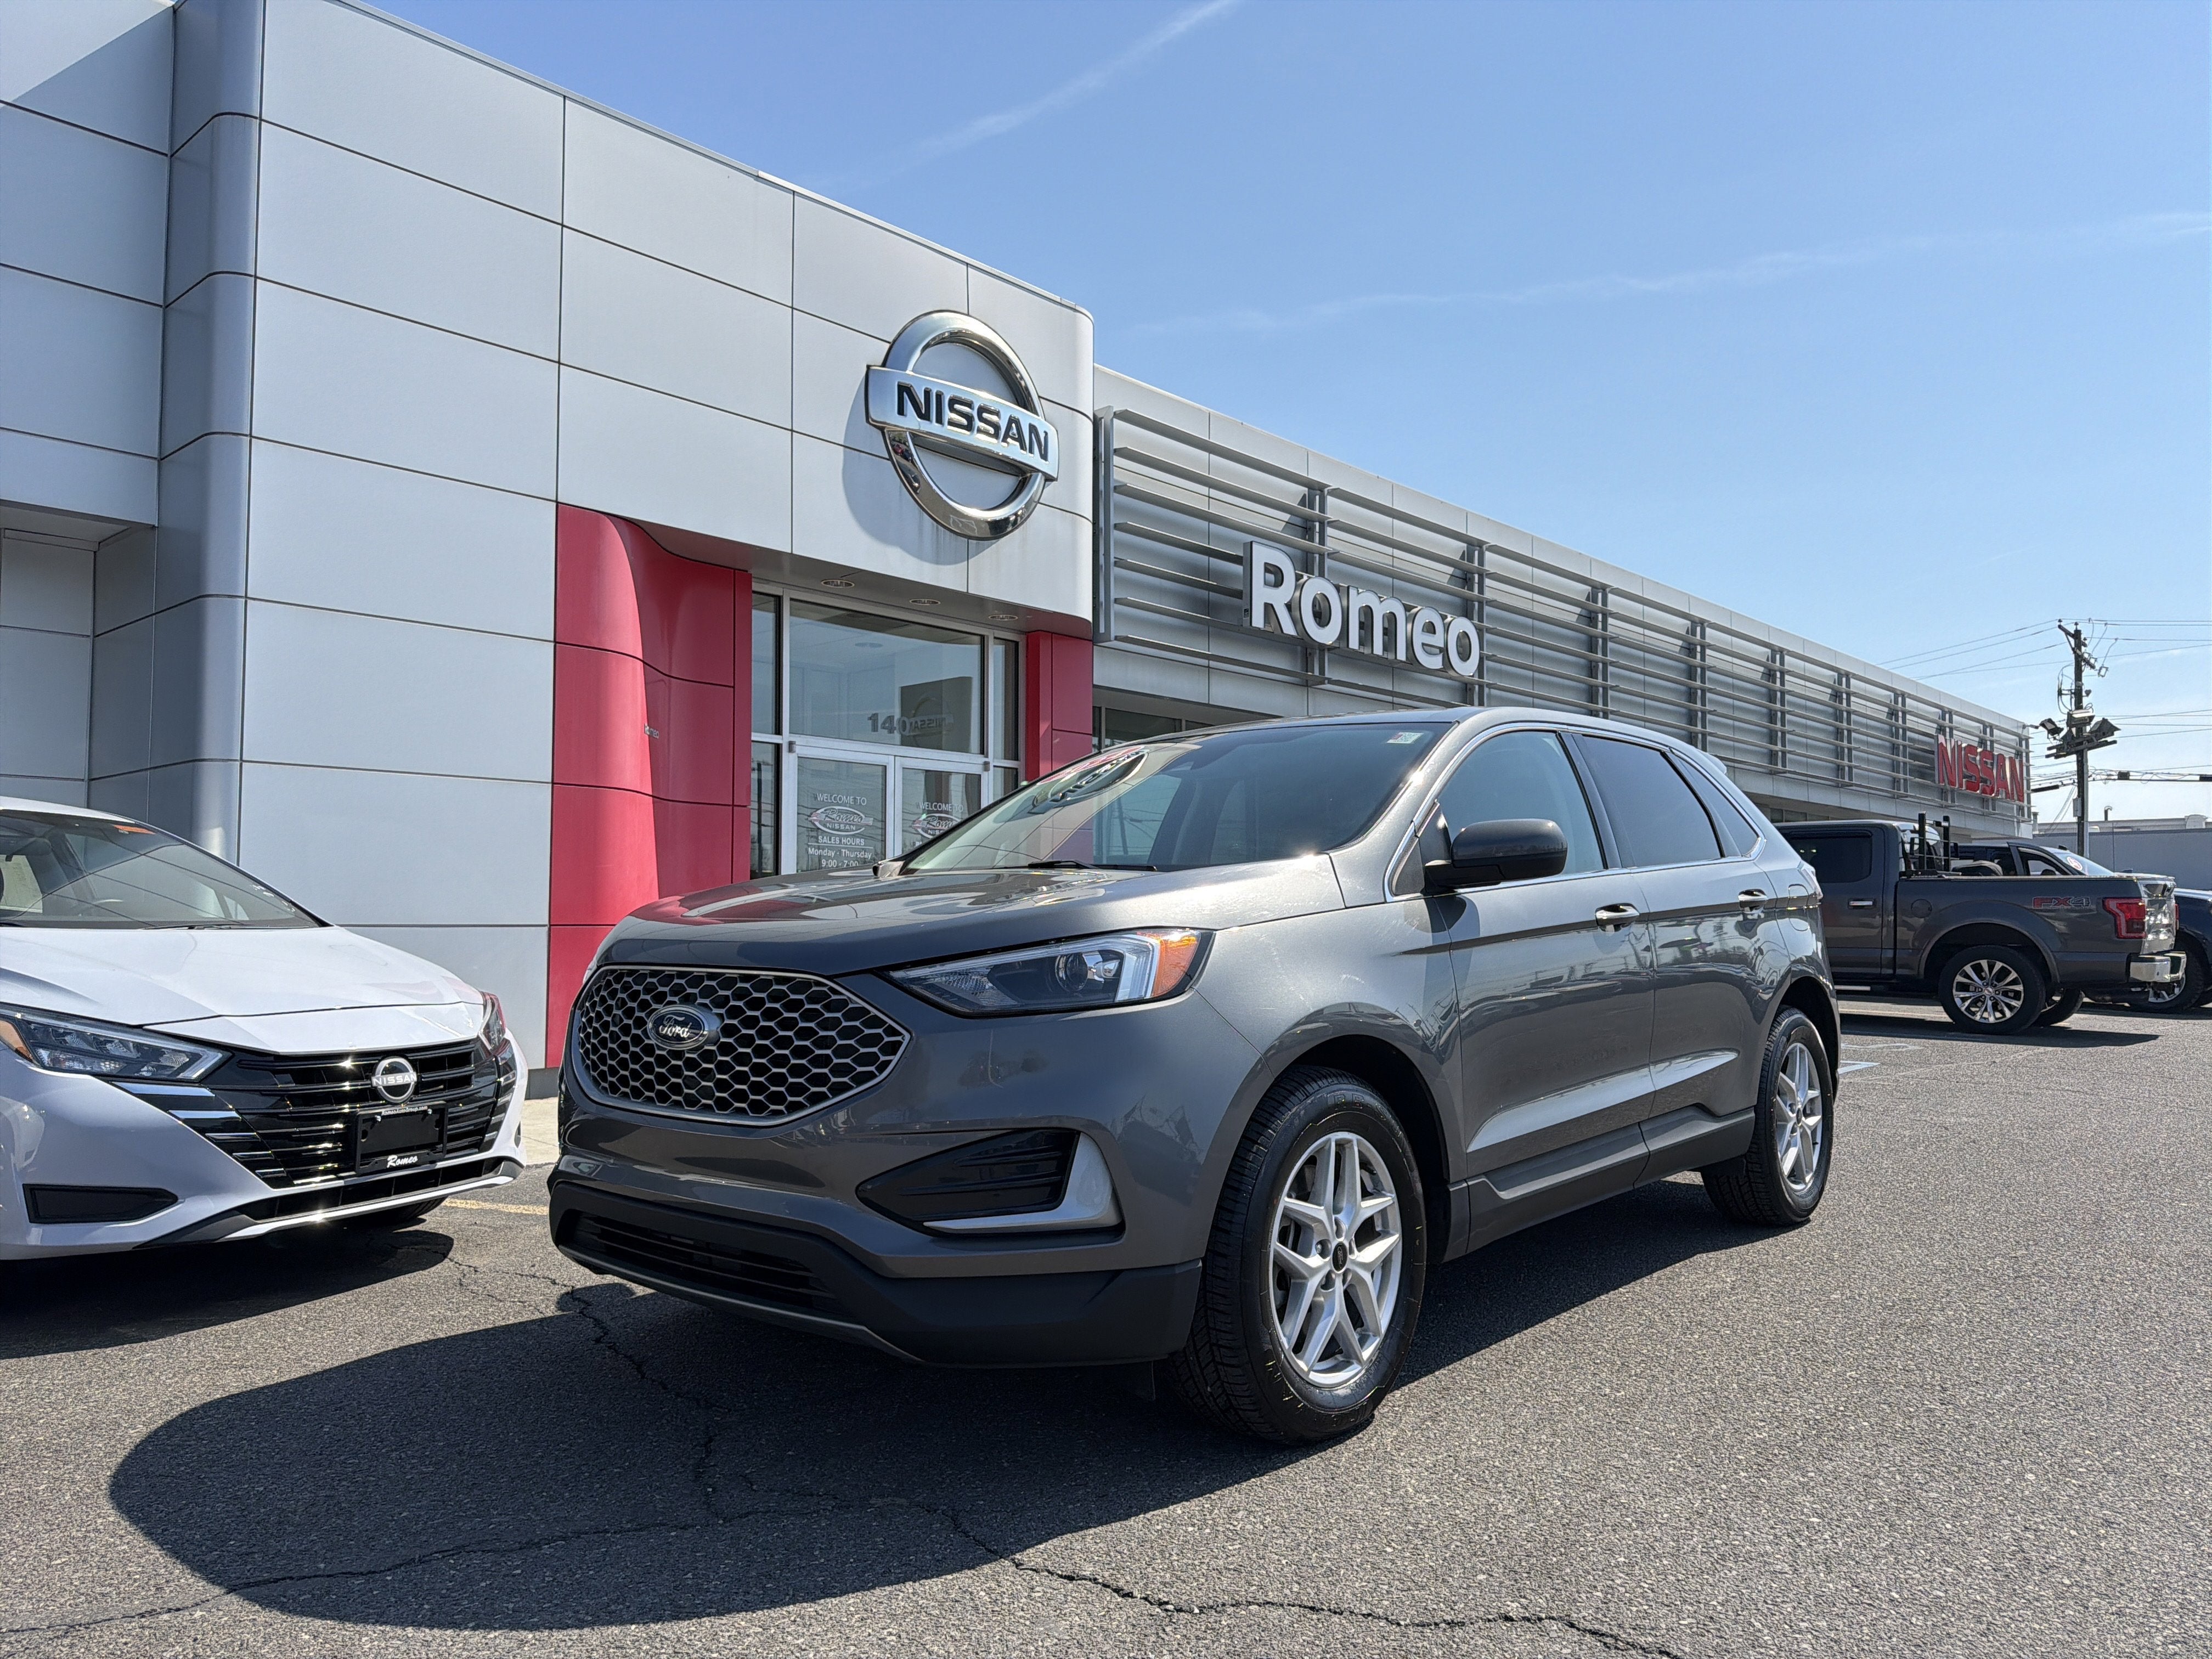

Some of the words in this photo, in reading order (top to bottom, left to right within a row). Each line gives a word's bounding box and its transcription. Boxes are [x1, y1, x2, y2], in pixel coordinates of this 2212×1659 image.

[897, 381, 1049, 464] NISSAN
[1244, 540, 1480, 676] Romeo
[867, 713, 910, 736] 140
[1936, 734, 2025, 803] NISSAN
[816, 793, 855, 804] WELCOME
[856, 797, 867, 805] TO
[919, 802, 952, 811] WELCOME
[955, 804, 964, 812] TO
[823, 807, 864, 823] Romeo
[926, 815, 953, 828] Rom
[818, 836, 839, 844] SALES
[842, 837, 865, 846] HOURS
[808, 848, 836, 858] Monday
[841, 849, 872, 859] Thursday
[821, 859, 837, 867] 9:00
[2033, 896, 2091, 909] FX4
[659, 1015, 692, 1038] Ford
[373, 1073, 417, 1085] NISSAN
[387, 1155, 418, 1168] Romeo
